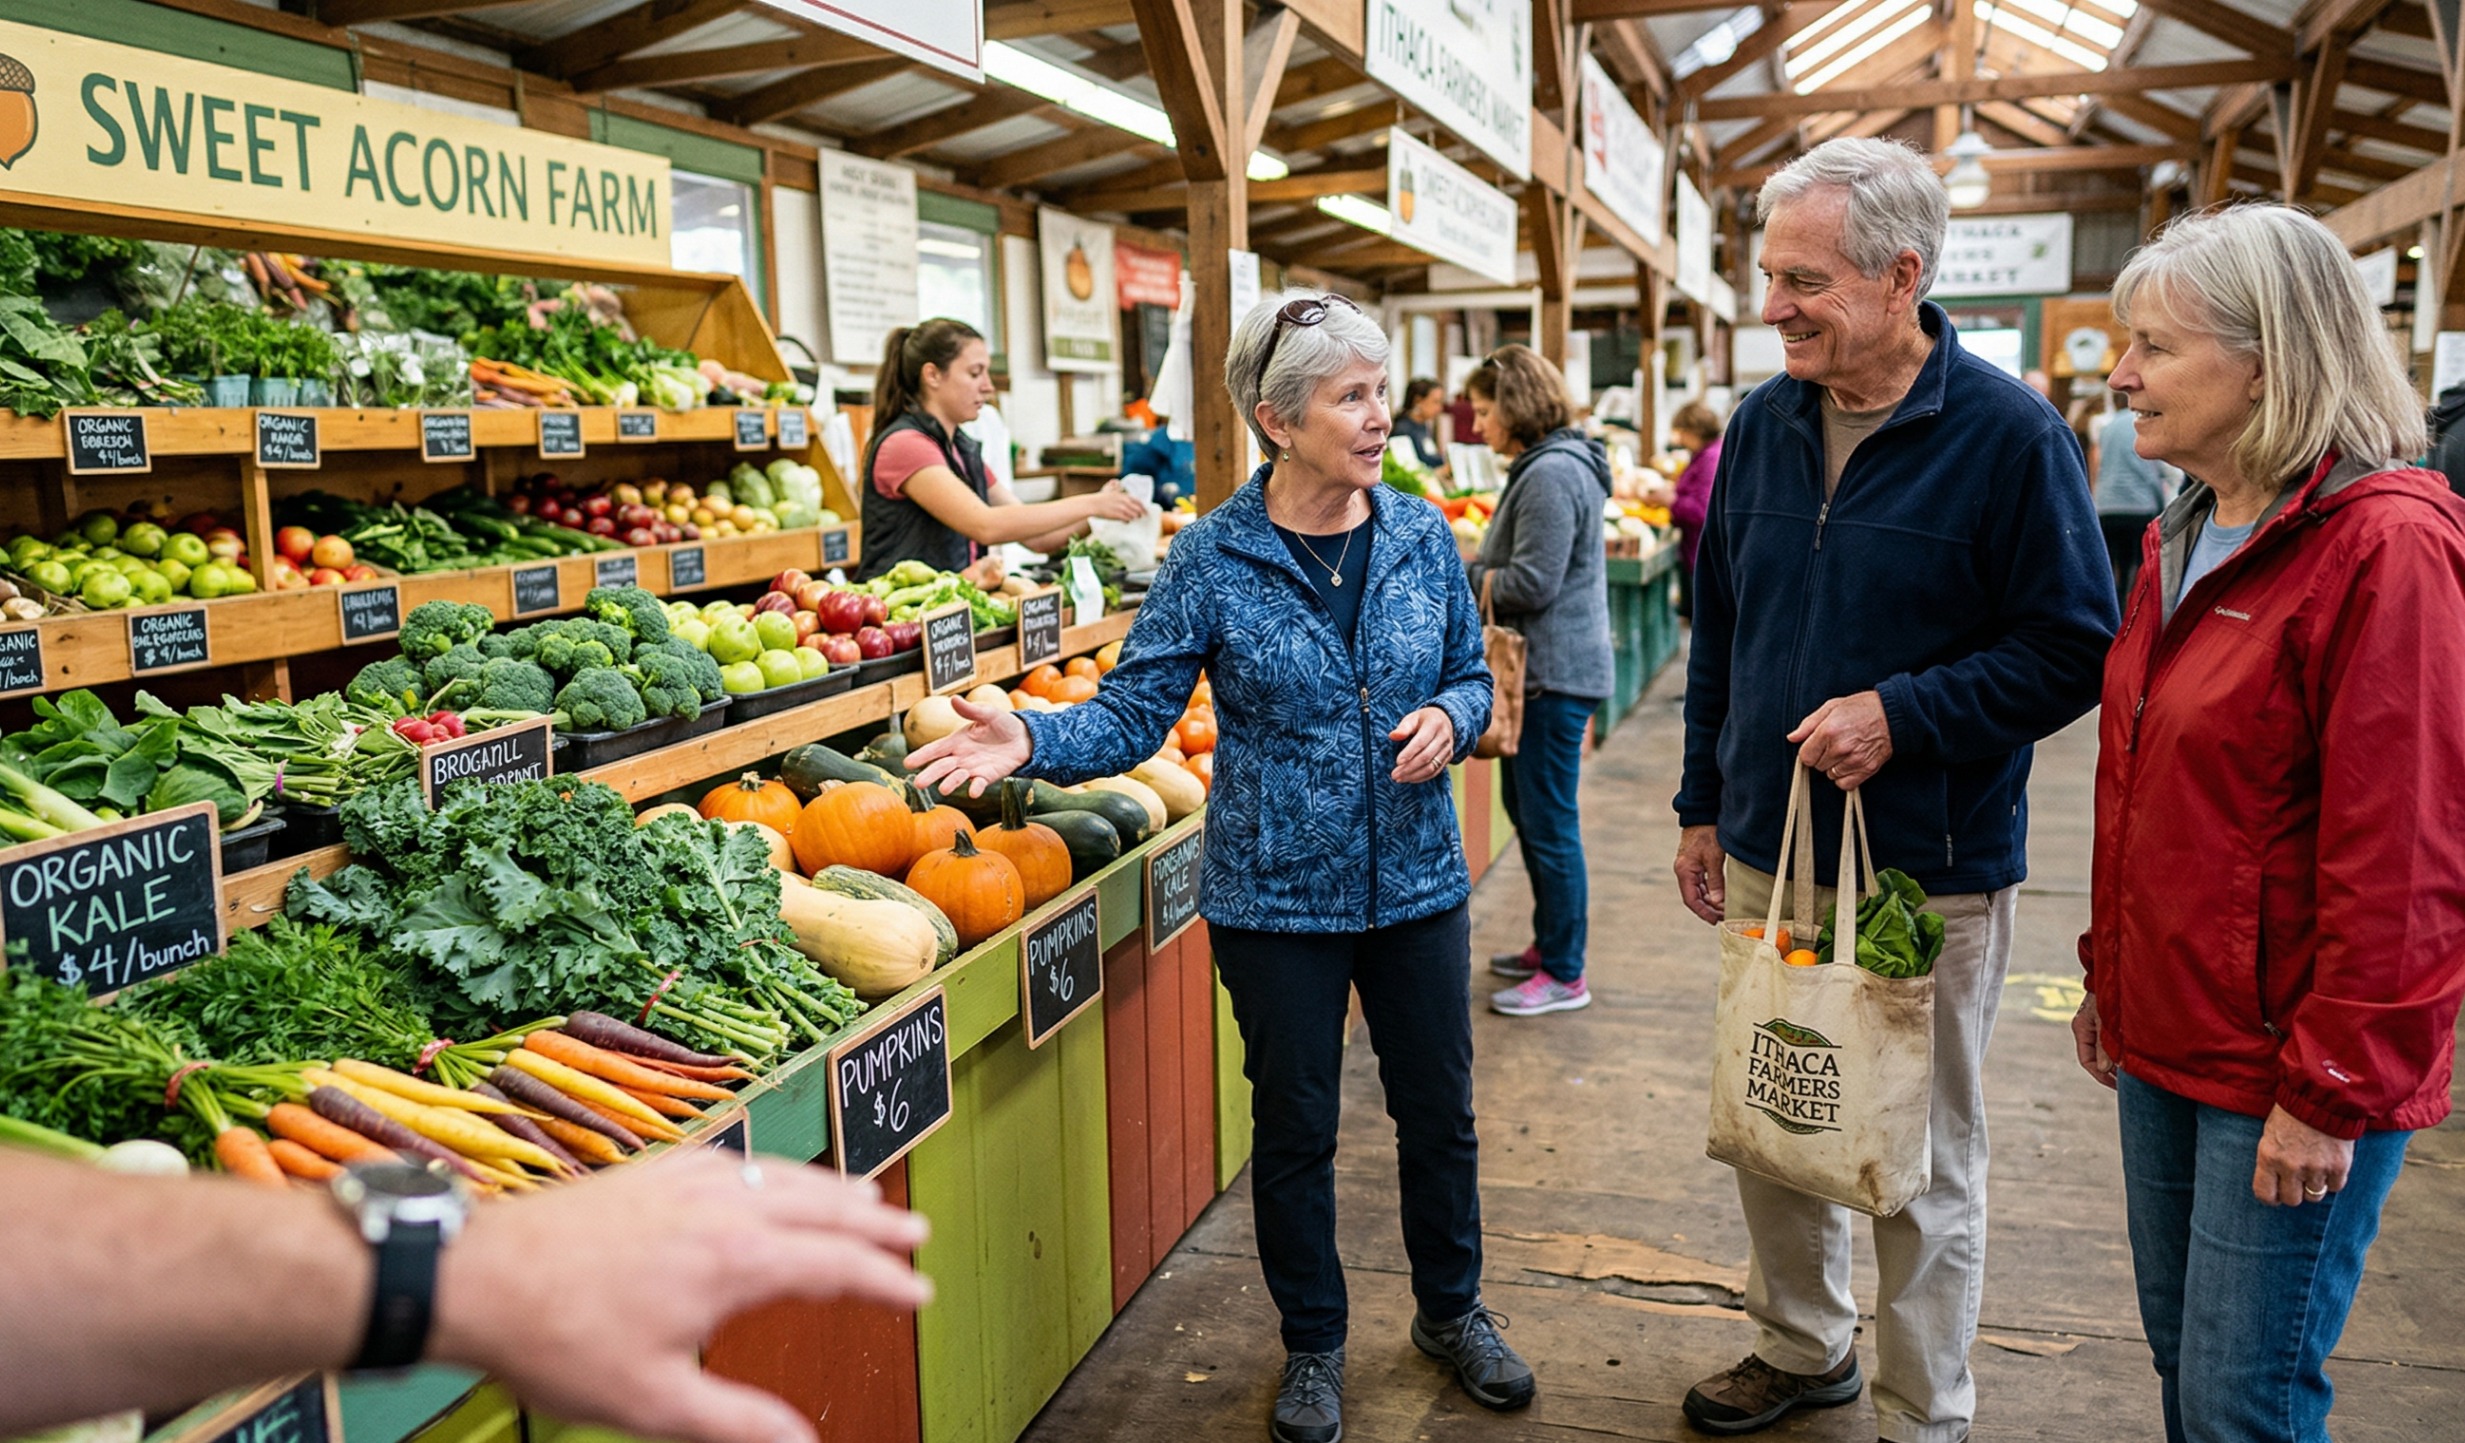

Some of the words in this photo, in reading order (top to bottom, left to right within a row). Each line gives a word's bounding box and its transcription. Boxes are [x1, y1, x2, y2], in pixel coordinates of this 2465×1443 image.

[1378, 0, 1435, 89] ITHACA
[80, 72, 321, 192] SWEET
[345, 124, 529, 222] ACORN
[546, 159, 657, 239] FARM
[78, 418, 134, 434] ORGANIC
[259, 414, 310, 433] ORGANIC
[140, 613, 194, 634] ORGANIC
[9, 824, 195, 909] ORGANIC
[1163, 865, 1190, 902] KALE
[47, 873, 177, 953] KALE
[1029, 902, 1097, 977] PUMPKINS
[1048, 956, 1075, 1002] $6
[840, 1005, 944, 1109] PUMPKINS
[1747, 1055, 1841, 1100] FARMERS
[1750, 1030, 1841, 1078] ITHACA
[872, 1077, 911, 1133] $6
[1745, 1077, 1841, 1123] MARKET
